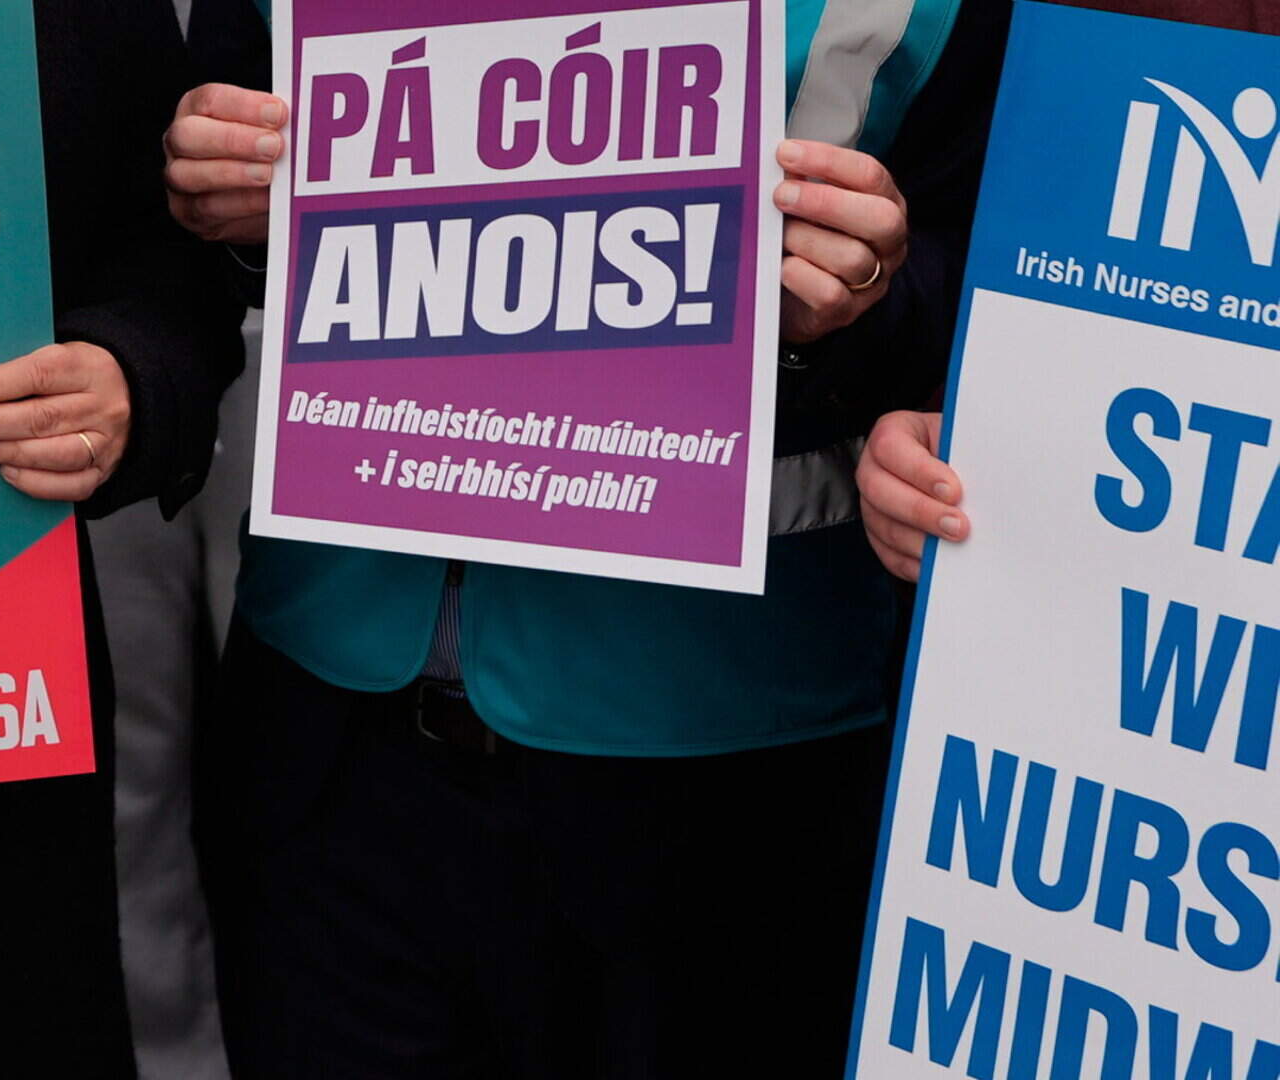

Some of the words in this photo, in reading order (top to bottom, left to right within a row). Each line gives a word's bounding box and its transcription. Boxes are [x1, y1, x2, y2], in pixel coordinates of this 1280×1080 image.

[306, 36, 435, 183] PÁ
[476, 21, 724, 171] CÓIR
[1107, 76, 1280, 267] IN
[297, 202, 721, 345] ANOIS!
[1016, 247, 1084, 287] Irish
[1093, 262, 1210, 313] Nurses
[1218, 293, 1280, 328] and
[286, 390, 361, 428] Déan
[365, 396, 555, 449] infheistíocht
[556, 415, 572, 449] i
[571, 420, 743, 466] múinteoirí
[354, 459, 376, 483] +
[380, 450, 399, 487] i
[397, 456, 553, 502] seirbhísí
[541, 474, 658, 514] poiblí!
[1094, 387, 1280, 565] ST
[1120, 587, 1280, 770] WI
[926, 734, 1280, 982] NURS
